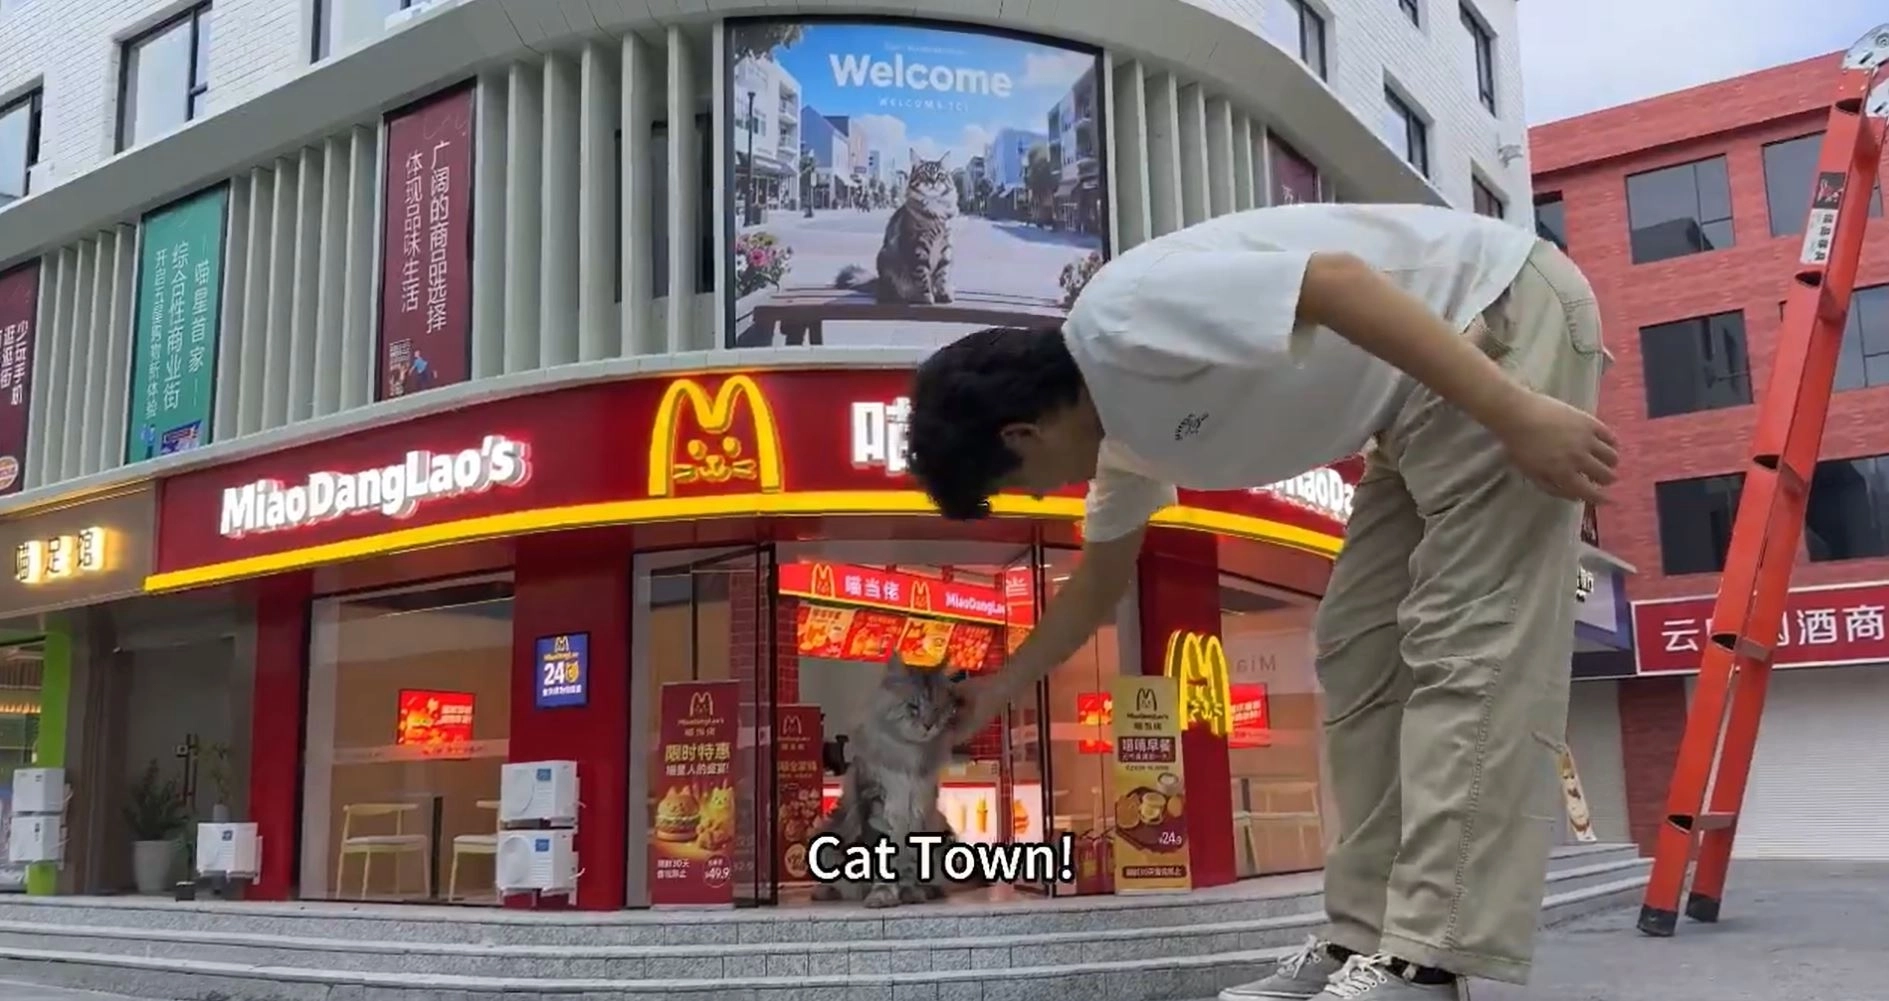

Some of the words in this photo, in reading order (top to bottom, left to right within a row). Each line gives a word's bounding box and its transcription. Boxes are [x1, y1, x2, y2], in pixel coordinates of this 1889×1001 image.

[829, 53, 1014, 97] Welcome
[401, 149, 423, 313] 体现品味生活
[426, 139, 450, 334] 广阔的商品选择
[163, 240, 188, 411] 综合性商业街
[220, 436, 528, 537] MiaoDangLao's
[845, 575, 899, 601] 喵当佬
[1661, 605, 1885, 652] 云酒商
[543, 661, 565, 685] 24
[664, 743, 731, 763] 限时特惠
